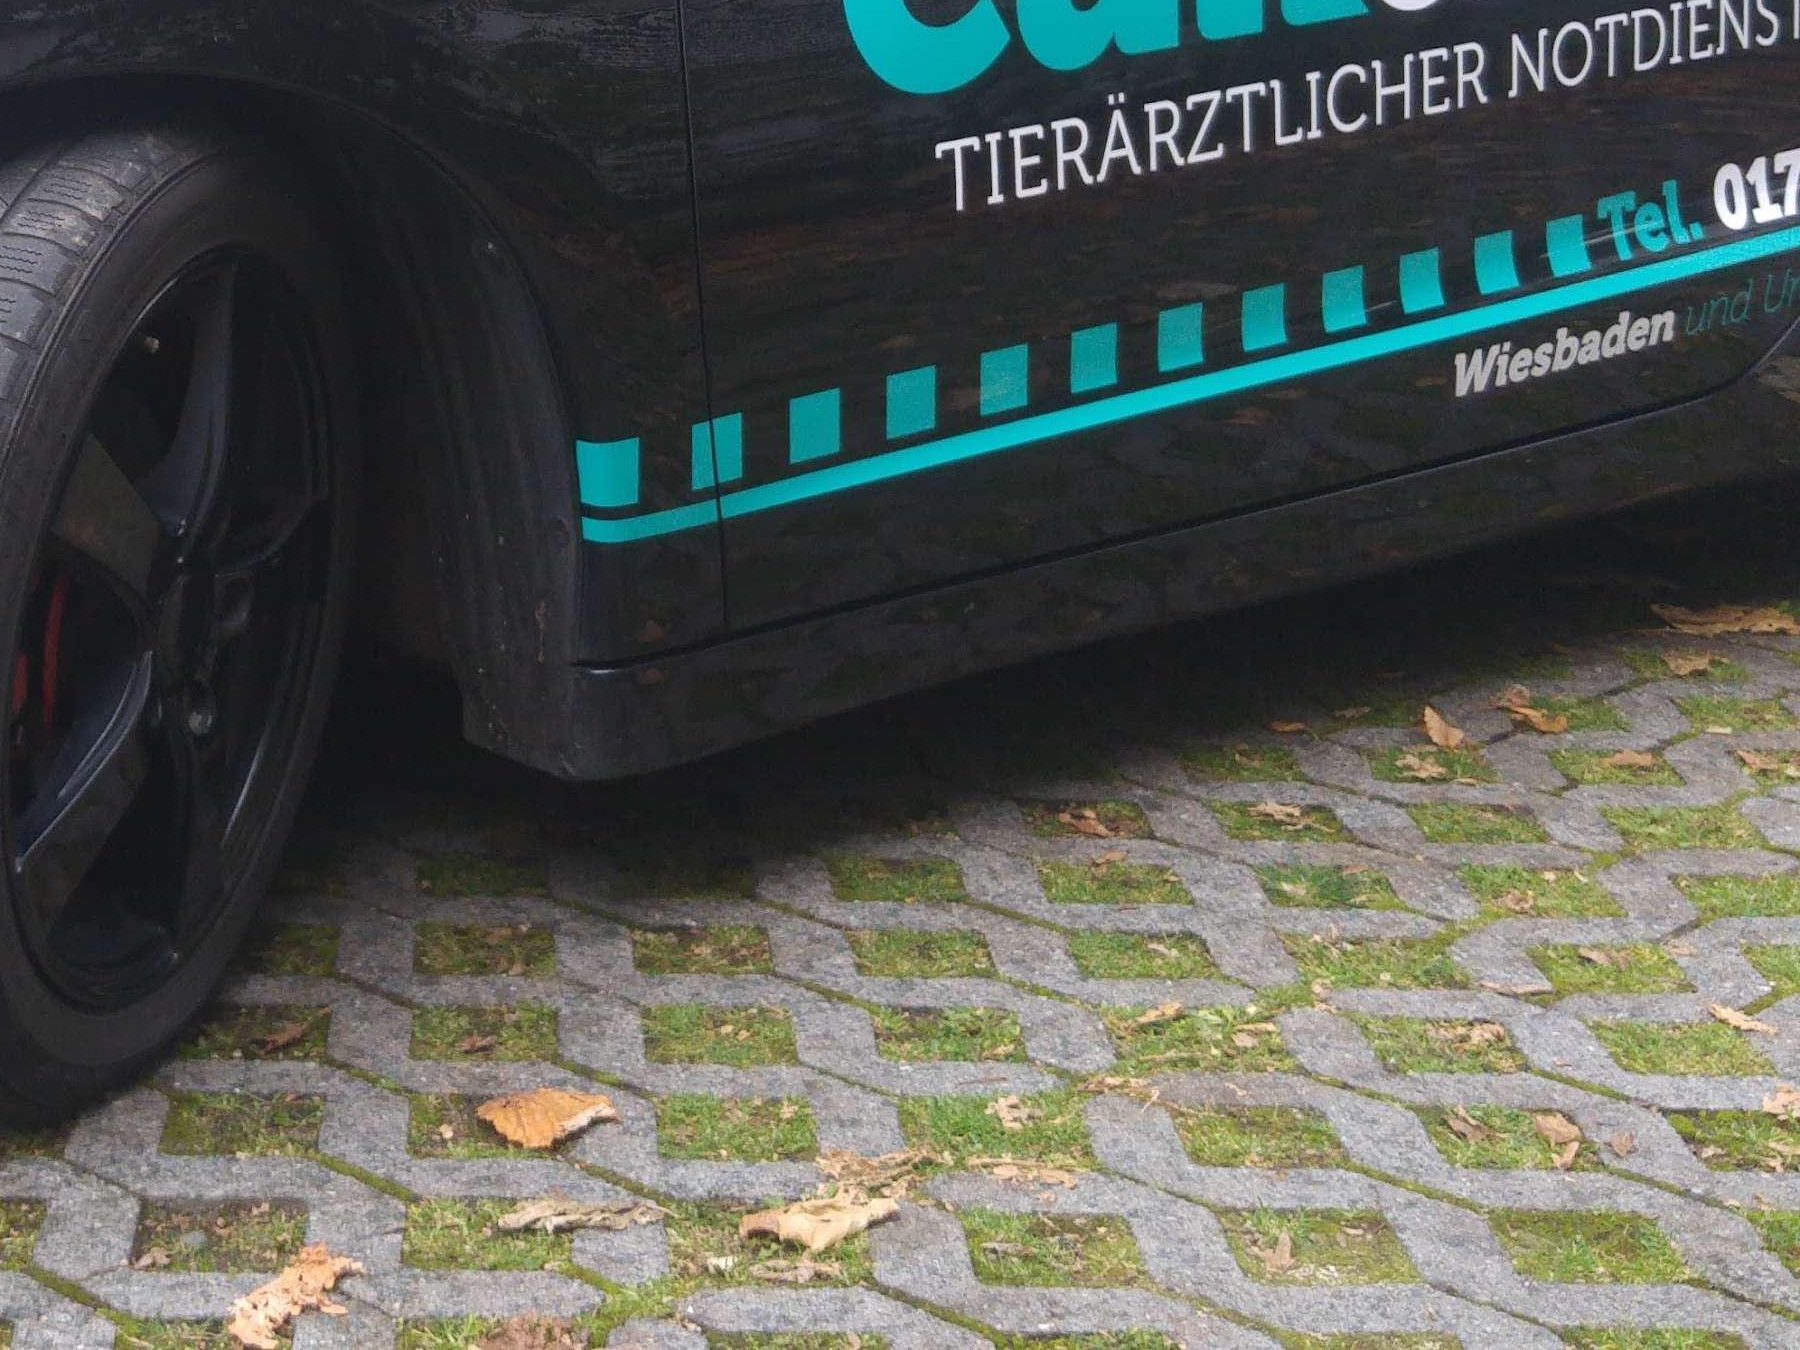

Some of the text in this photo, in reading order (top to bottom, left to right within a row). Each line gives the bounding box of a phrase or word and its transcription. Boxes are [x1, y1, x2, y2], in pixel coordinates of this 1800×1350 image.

[934, 41, 1488, 212] TIERÄRZTLICHER
[1597, 147, 1800, 261] Tel. 017
[1454, 309, 1676, 397] Wiesbaden
[1686, 278, 1753, 336] und
